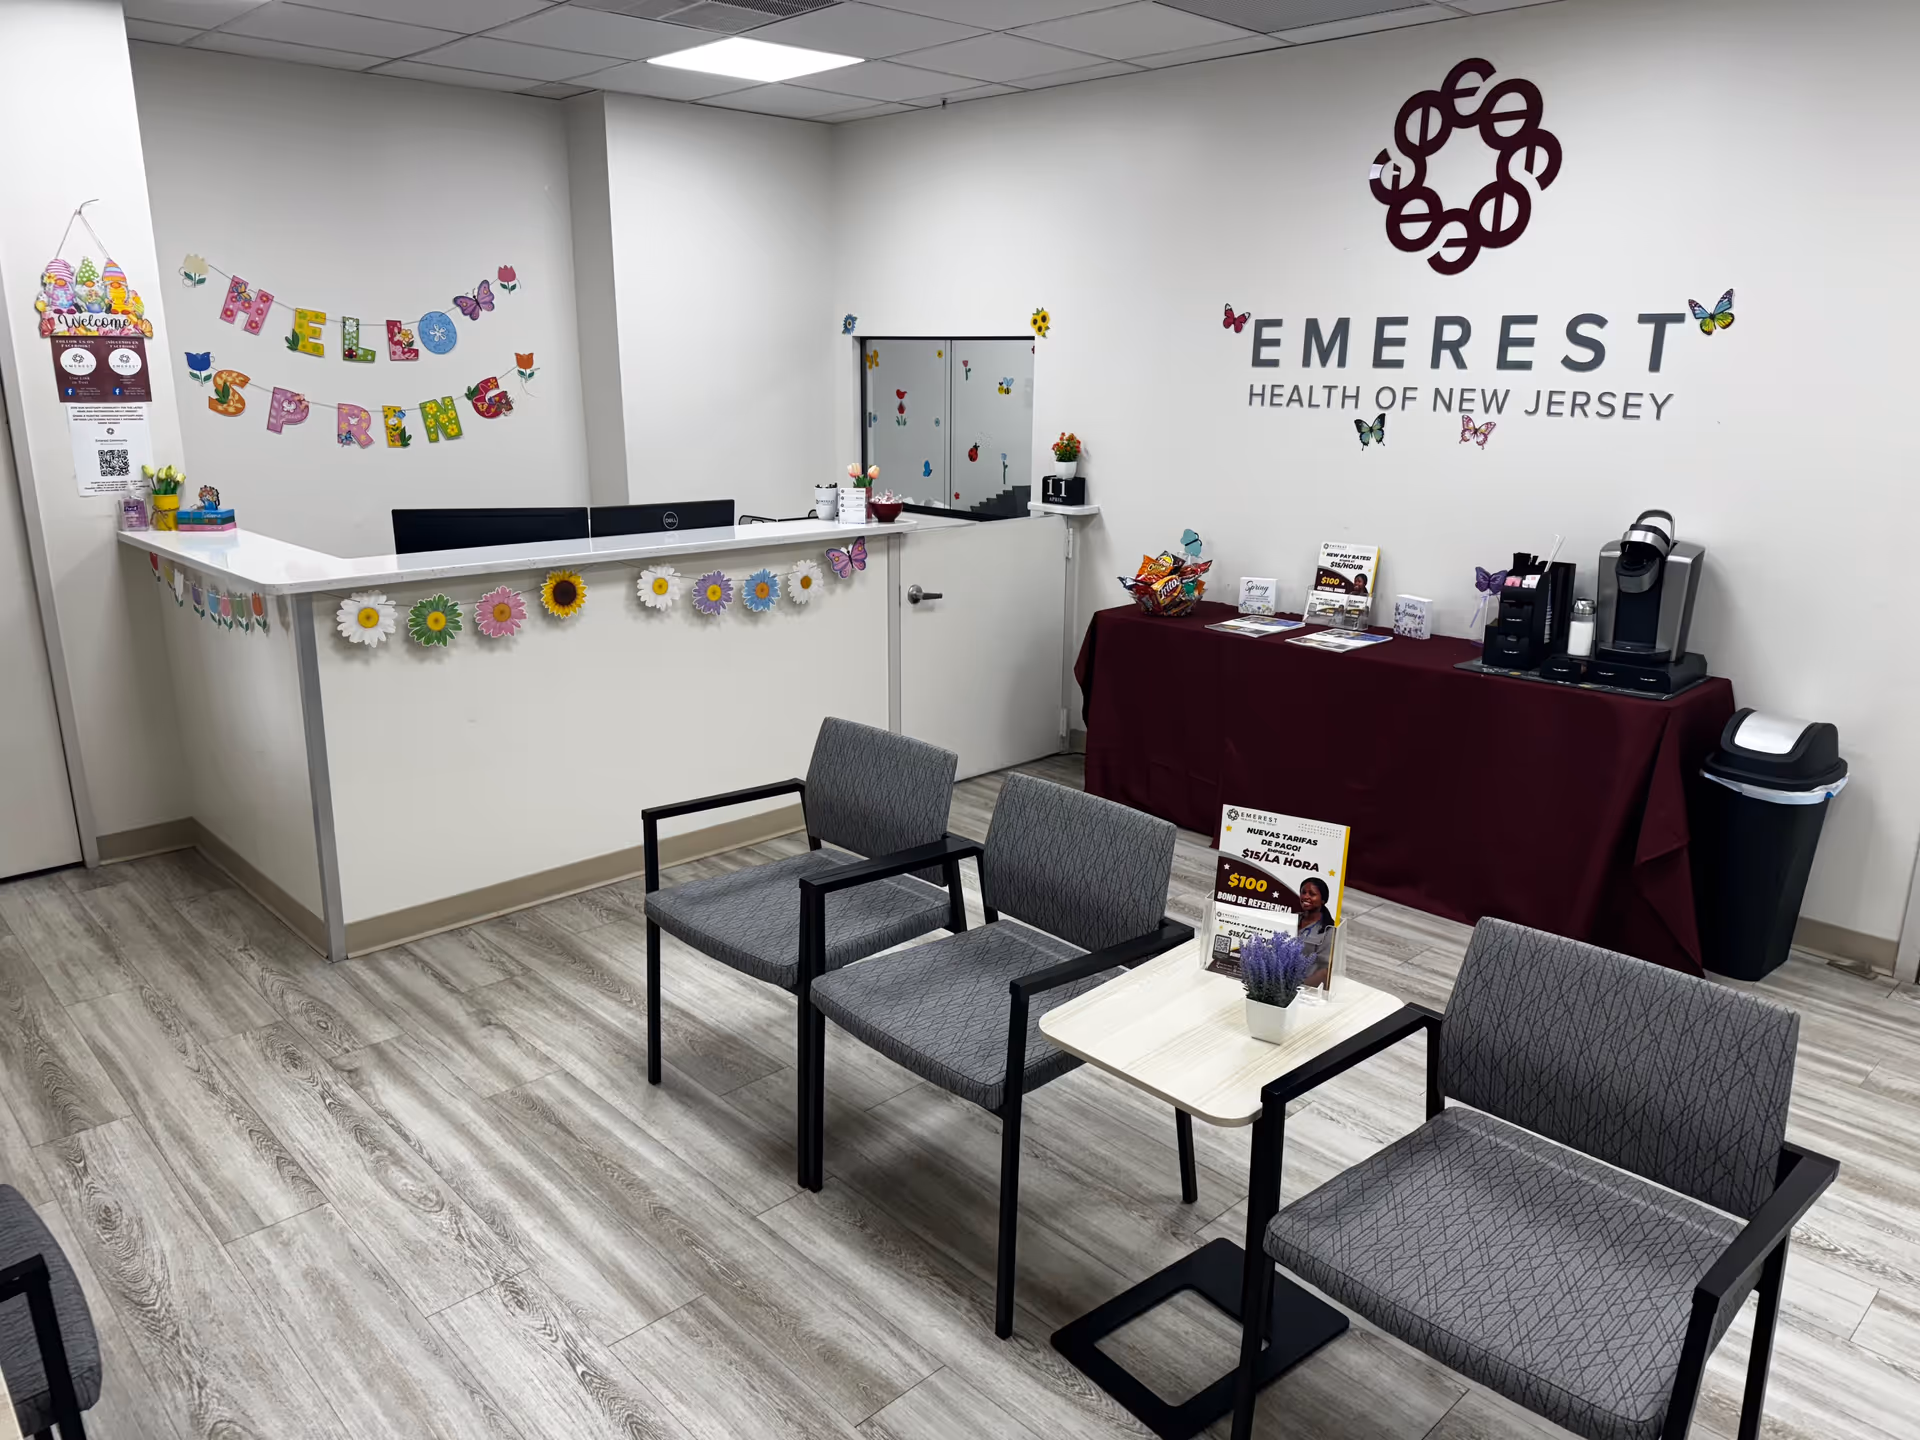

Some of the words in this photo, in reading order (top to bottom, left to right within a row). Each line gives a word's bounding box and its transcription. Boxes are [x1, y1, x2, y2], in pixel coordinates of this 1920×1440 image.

[57, 314, 132, 330] Welcome
[219, 274, 458, 363] HELLO
[1251, 312, 1687, 374] EMEREST
[208, 369, 514, 449] SPRING
[1248, 383, 1361, 410] HEALTH
[1375, 386, 1419, 411] OF
[1432, 387, 1511, 415] NEW
[1524, 389, 1675, 421] JERSEY
[1330, 561, 1363, 570] $15/HOUR
[1245, 580, 1269, 597] Spring
[1321, 576, 1340, 585] $100
[1240, 812, 1277, 823] EMEREST
[1246, 827, 1280, 839] NUEVAS
[1282, 834, 1318, 846] TARIFAS
[1261, 839, 1273, 847] DE
[1274, 841, 1301, 852] PAGO!
[1241, 848, 1280, 864] $15/LA
[1283, 857, 1319, 872] HORA
[1267, 848, 1290, 856] EMPIEZA
[1227, 872, 1268, 892] $100
[1217, 891, 1236, 902] BONO
[1237, 896, 1247, 905] DE
[1248, 898, 1292, 913] REFERENCIA
